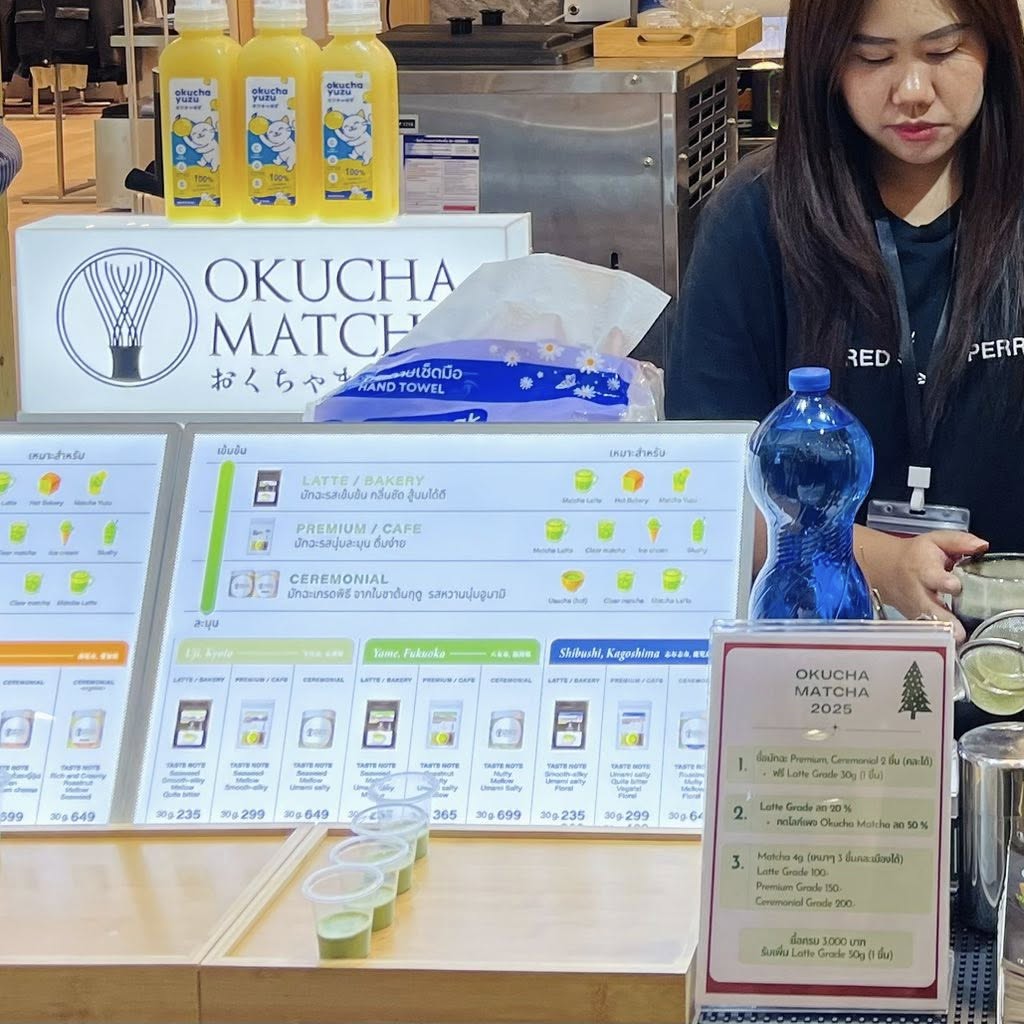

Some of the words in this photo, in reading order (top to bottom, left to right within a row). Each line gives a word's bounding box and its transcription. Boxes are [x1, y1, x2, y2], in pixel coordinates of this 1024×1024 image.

[326, 81, 363, 89] okucha
[174, 88, 211, 97] okucha
[252, 87, 288, 95] okucha
[327, 89, 351, 97] yuzu
[175, 96, 200, 104] yuzu
[252, 94, 277, 103] yuzu
[205, 257, 456, 303] OKUCHA
[209, 312, 422, 357] MATCH
[847, 349, 891, 367] RED
[358, 382, 396, 392] HAND
[399, 382, 445, 394] TOWEL
[302, 476, 348, 486] LATTE
[364, 476, 424, 486] BAKERY
[296, 524, 367, 534] PREMIUM
[382, 523, 422, 534] CAFE
[289, 574, 389, 585] CEREMONIAL
[558, 648, 604, 659] Shibushi,
[606, 648, 660, 662] Kagoshima
[795, 668, 869, 681] OKUCHA
[794, 685, 870, 698] MATCHA
[810, 703, 853, 715] 2025
[738, 757, 748, 772] 1.
[831, 755, 878, 765] Ceremonial
[787, 769, 810, 778] Latte
[812, 769, 839, 779] Grade
[71, 811, 95, 821] 649
[176, 809, 201, 820] 235
[241, 809, 265, 820] 299
[304, 809, 329, 820] 649
[433, 810, 457, 820] 365
[497, 810, 522, 820] 699
[561, 810, 585, 820] 235
[625, 810, 649, 820] 299
[733, 806, 748, 820] 2.
[760, 802, 784, 812] Latte
[786, 803, 813, 812] Grade
[830, 805, 842, 813] 20
[820, 817, 854, 827] Okucha
[857, 819, 890, 829] Matcha
[907, 821, 918, 829] 50
[731, 854, 745, 870] 3.
[757, 851, 791, 861] Matcha
[756, 866, 779, 876] Latte
[782, 866, 809, 876] Grade
[756, 881, 793, 891] Premium
[796, 882, 823, 892] Grade
[755, 896, 804, 907] Ceremonial
[806, 897, 833, 908] Grade
[791, 948, 815, 957] Latte
[817, 948, 846, 958] Grade
